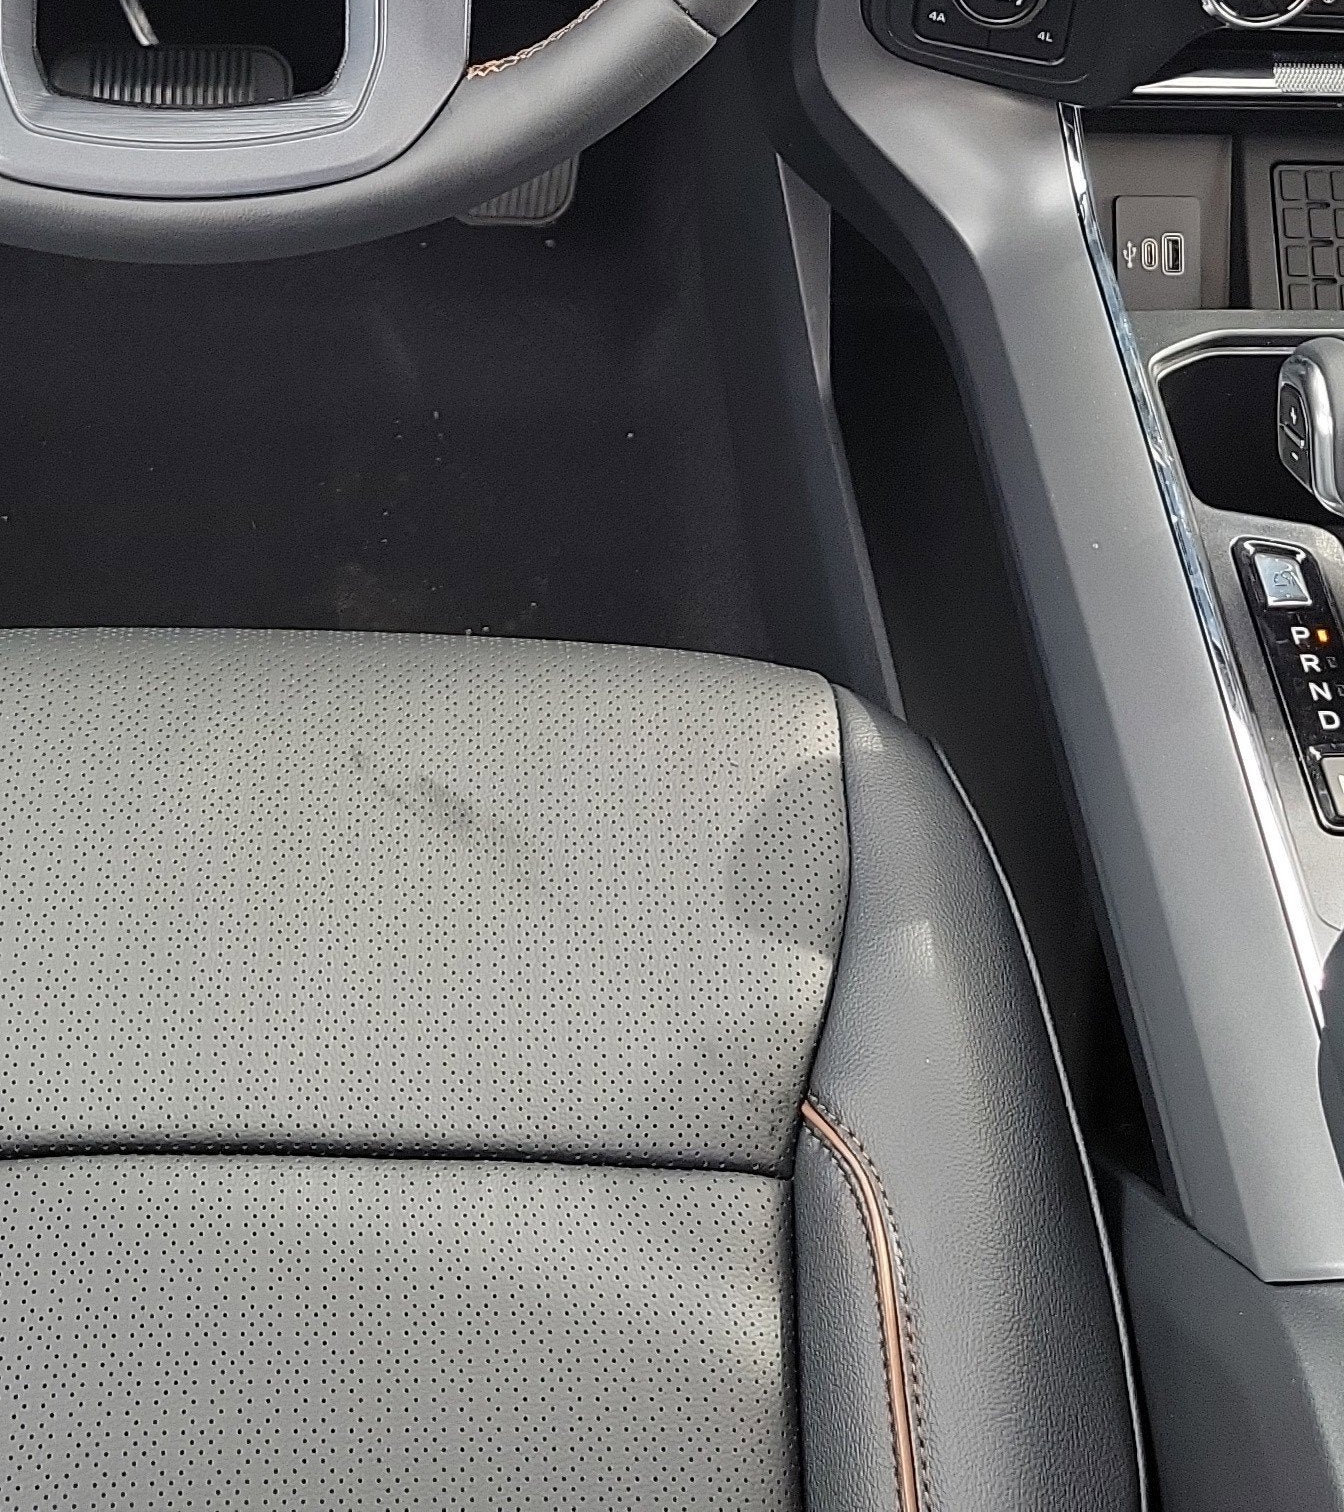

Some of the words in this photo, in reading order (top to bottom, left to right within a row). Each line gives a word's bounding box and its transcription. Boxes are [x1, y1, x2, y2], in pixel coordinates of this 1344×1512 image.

[929, 11, 946, 23] 4A
[1037, 30, 1053, 43] 4L
[1291, 626, 1310, 646] P
[1300, 653, 1321, 672] R
[1309, 681, 1332, 701] N
[1317, 710, 1341, 730] D
